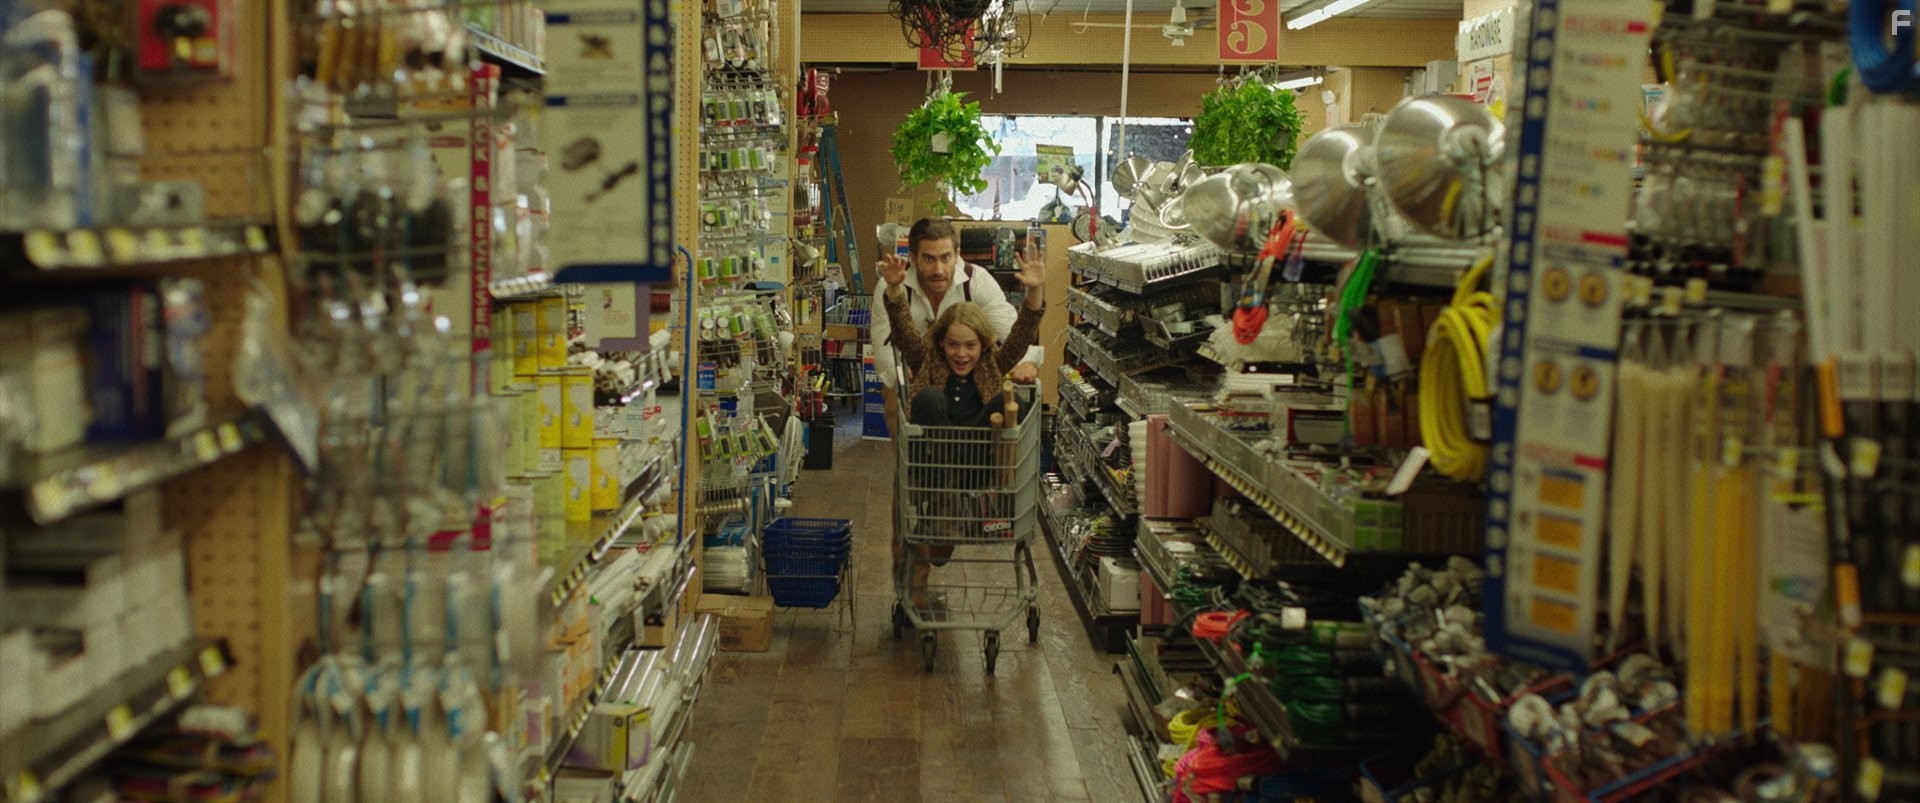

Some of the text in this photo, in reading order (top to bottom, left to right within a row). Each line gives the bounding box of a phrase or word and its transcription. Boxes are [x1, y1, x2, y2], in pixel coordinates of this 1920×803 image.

[1227, 0, 1268, 55] 5
[1470, 17, 1502, 51] HARDWARE
[1486, 441, 1514, 578] CORDS
